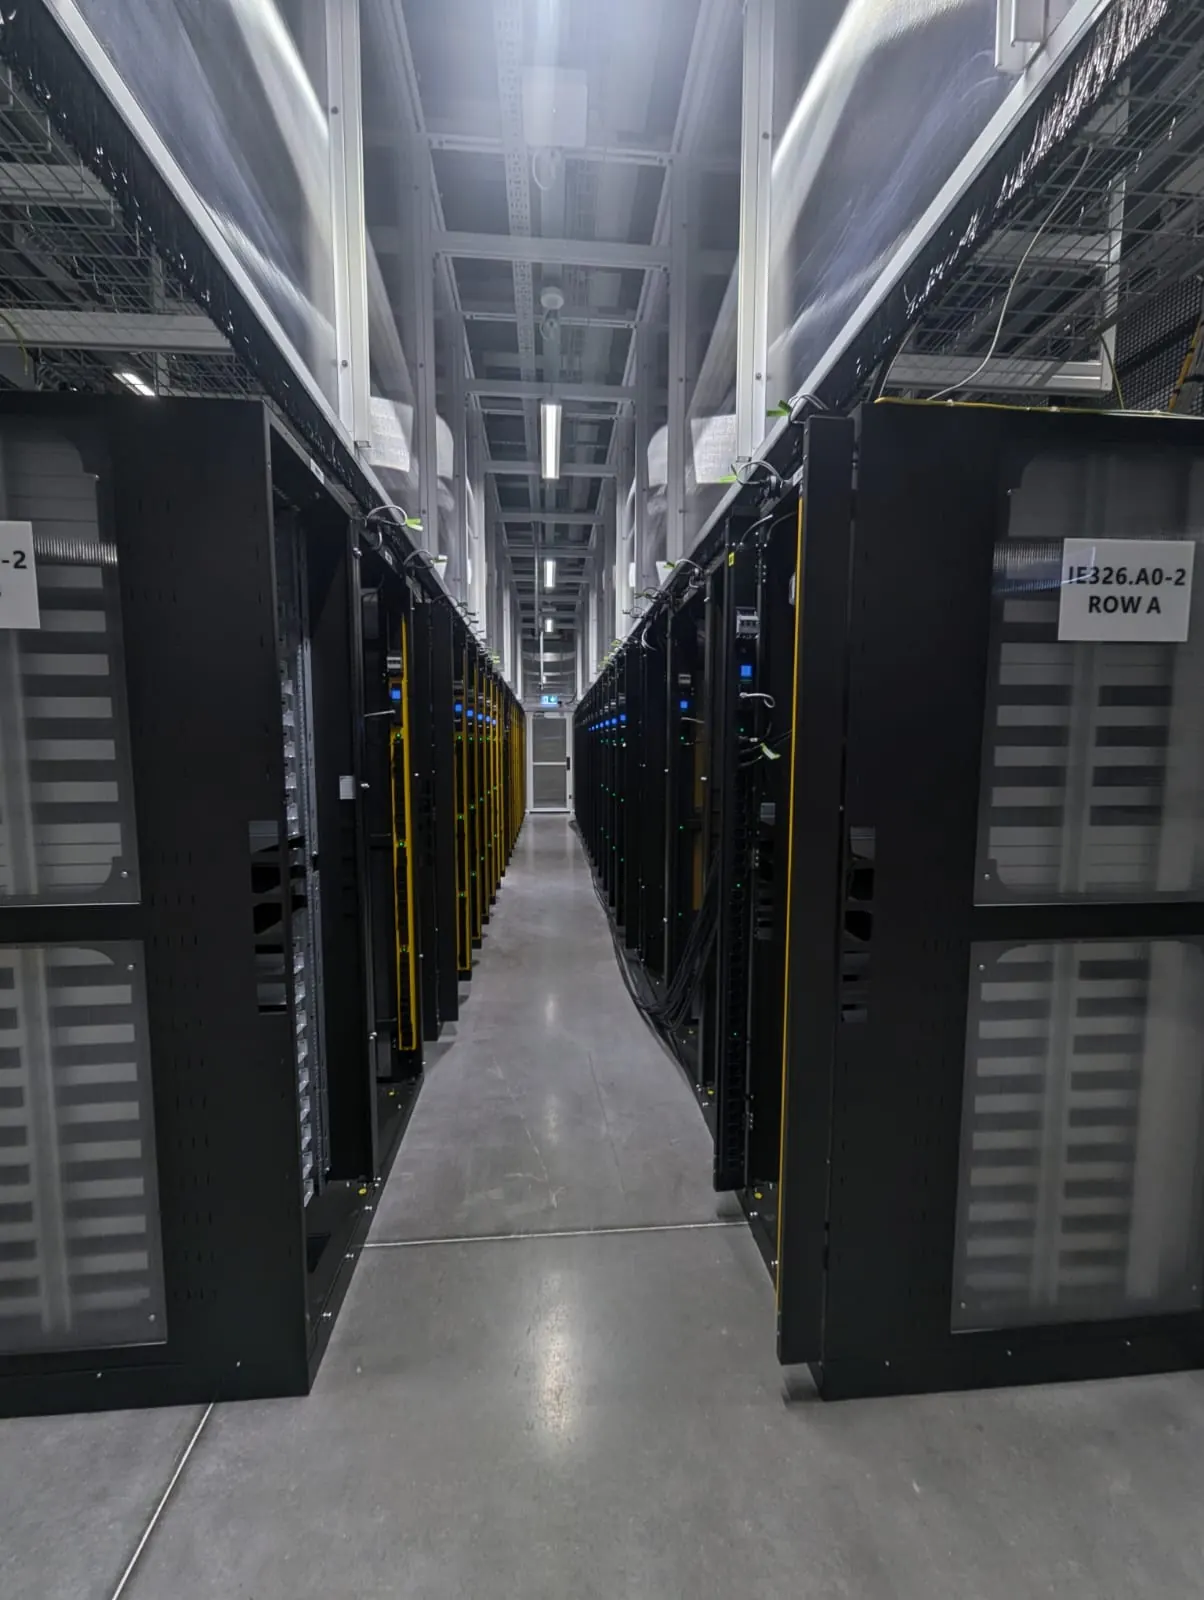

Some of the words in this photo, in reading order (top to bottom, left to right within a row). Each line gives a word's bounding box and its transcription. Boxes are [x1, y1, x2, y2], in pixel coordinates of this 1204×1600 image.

[1068, 566, 1187, 586] IE326.A0-2
[1088, 595, 1142, 614] ROW
[1146, 596, 1162, 614] A
